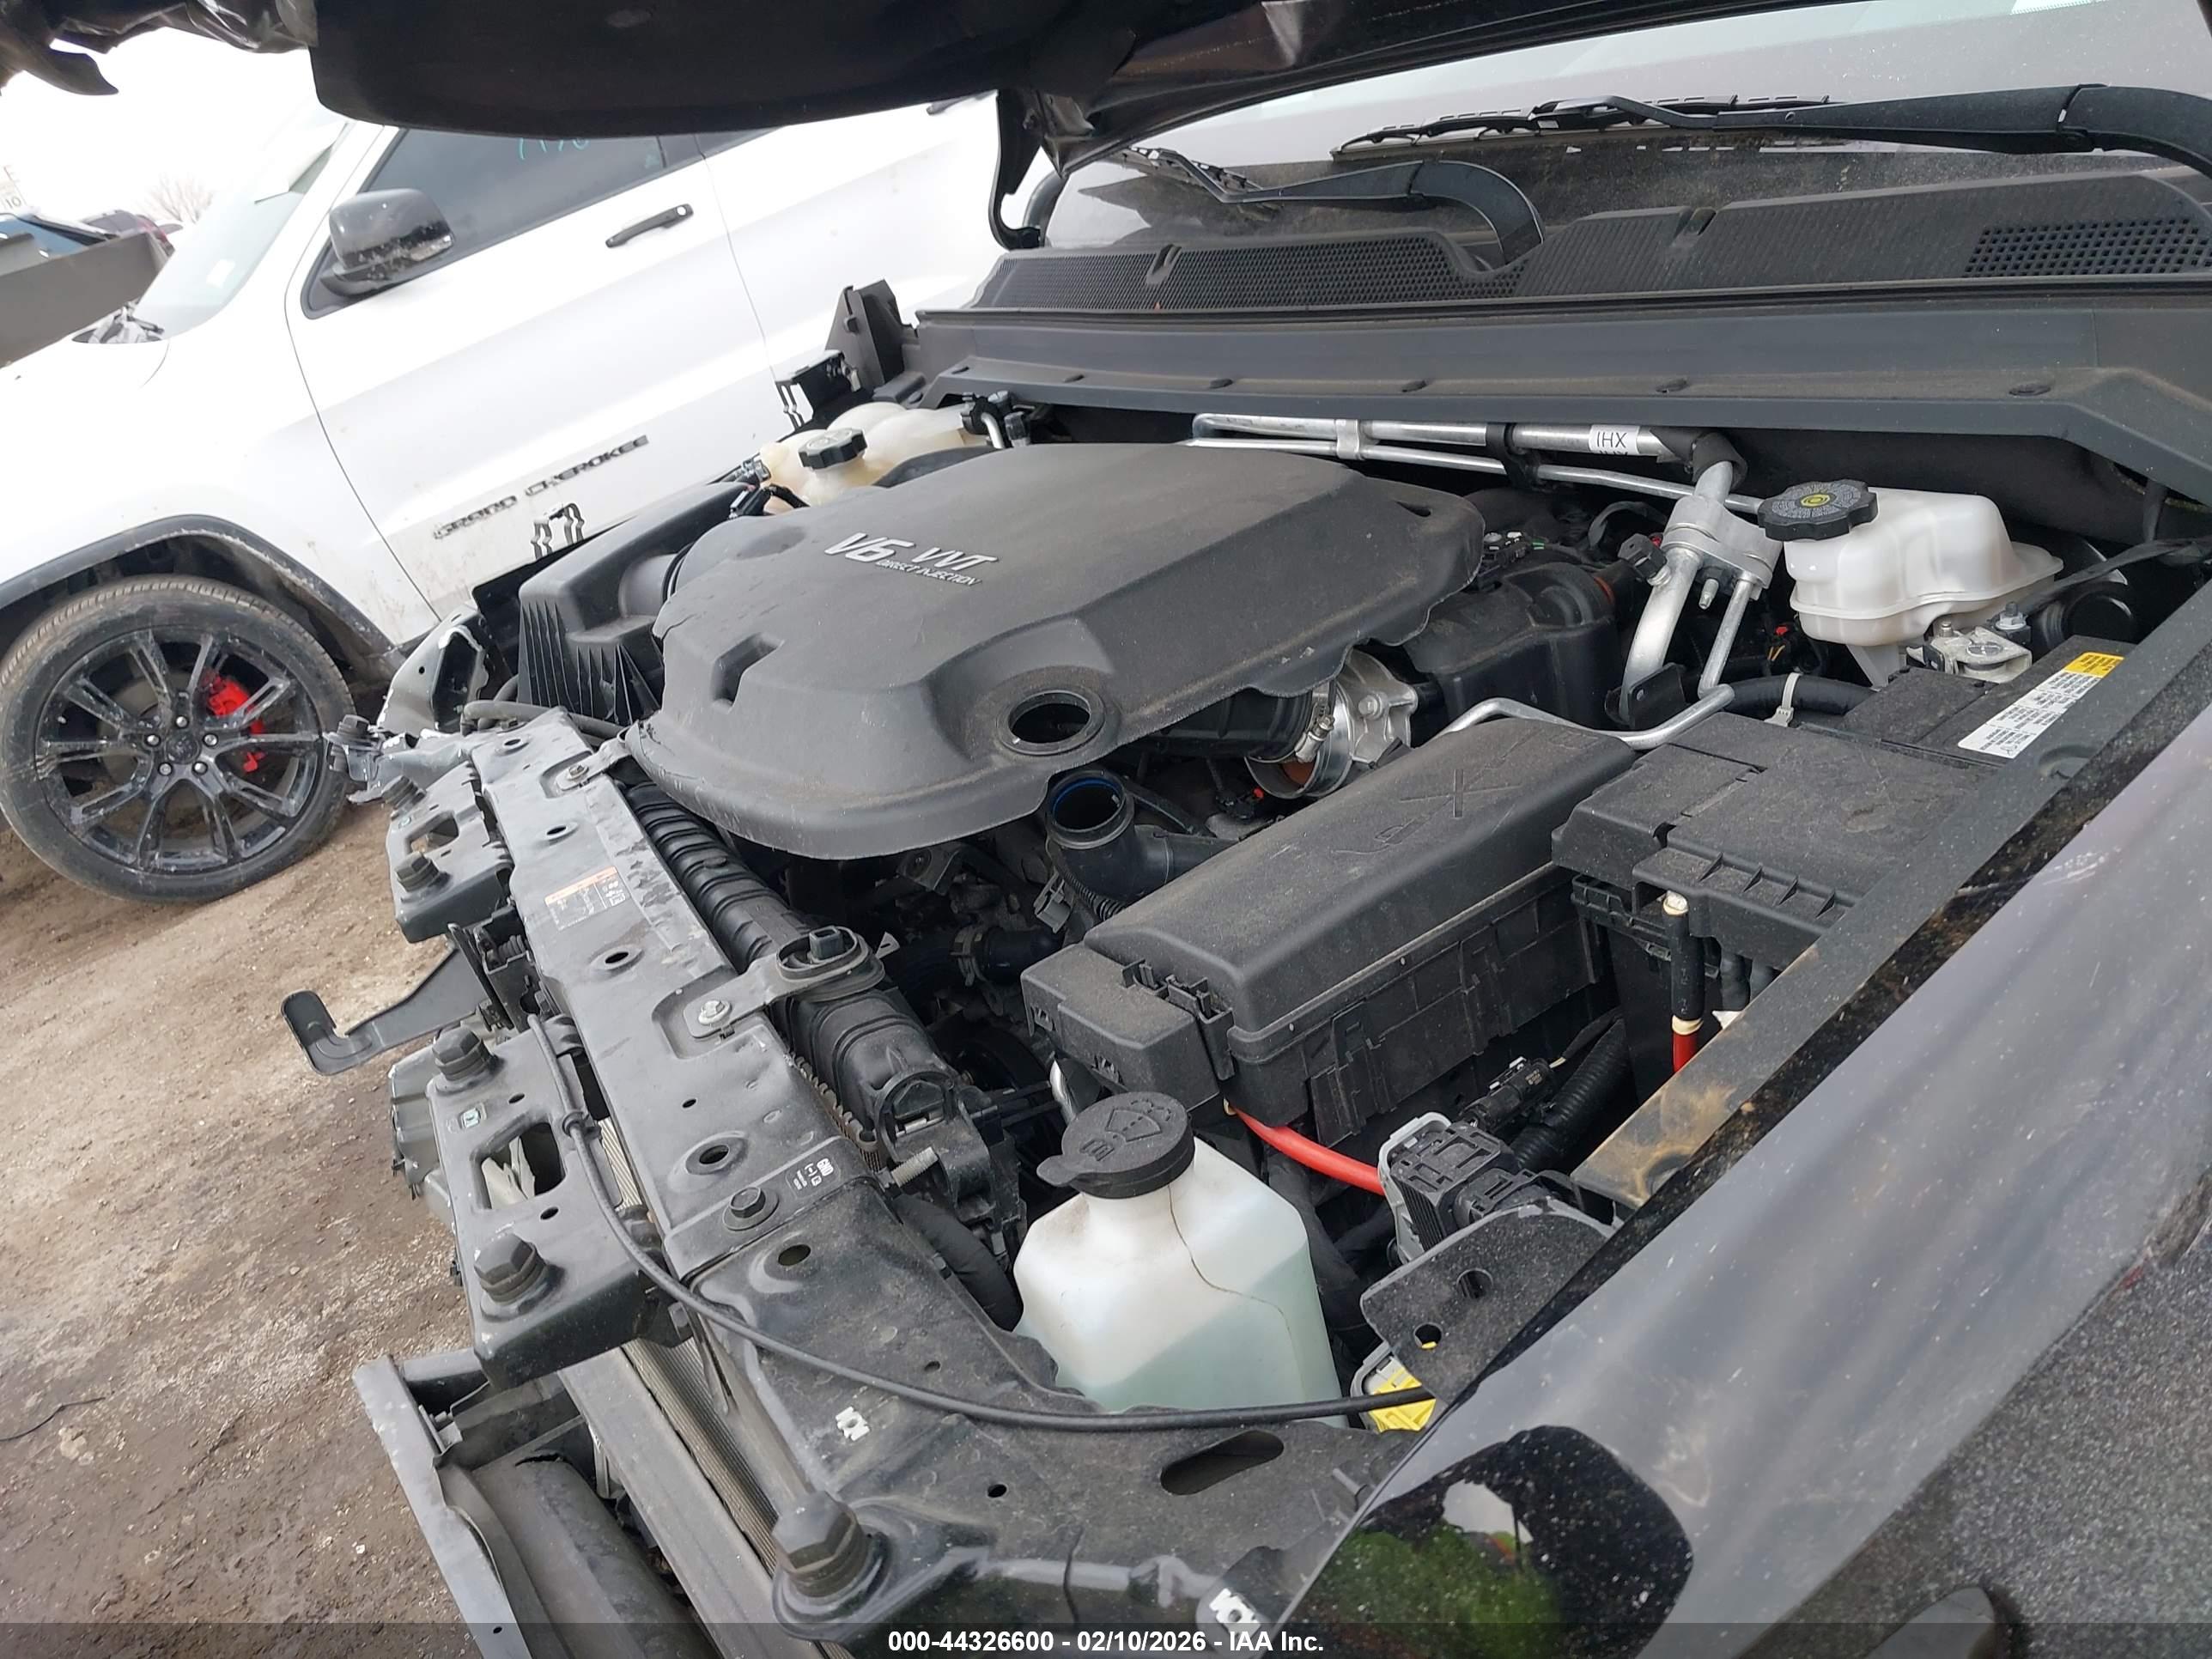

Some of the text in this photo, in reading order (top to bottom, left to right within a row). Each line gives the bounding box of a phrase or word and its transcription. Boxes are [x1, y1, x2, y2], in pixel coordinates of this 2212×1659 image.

[1596, 430, 1627, 449] IHX
[433, 434, 650, 540] GRAND CHEROKEE
[823, 532, 1000, 572] V6 VVT
[875, 559, 920, 574] DIRECT
